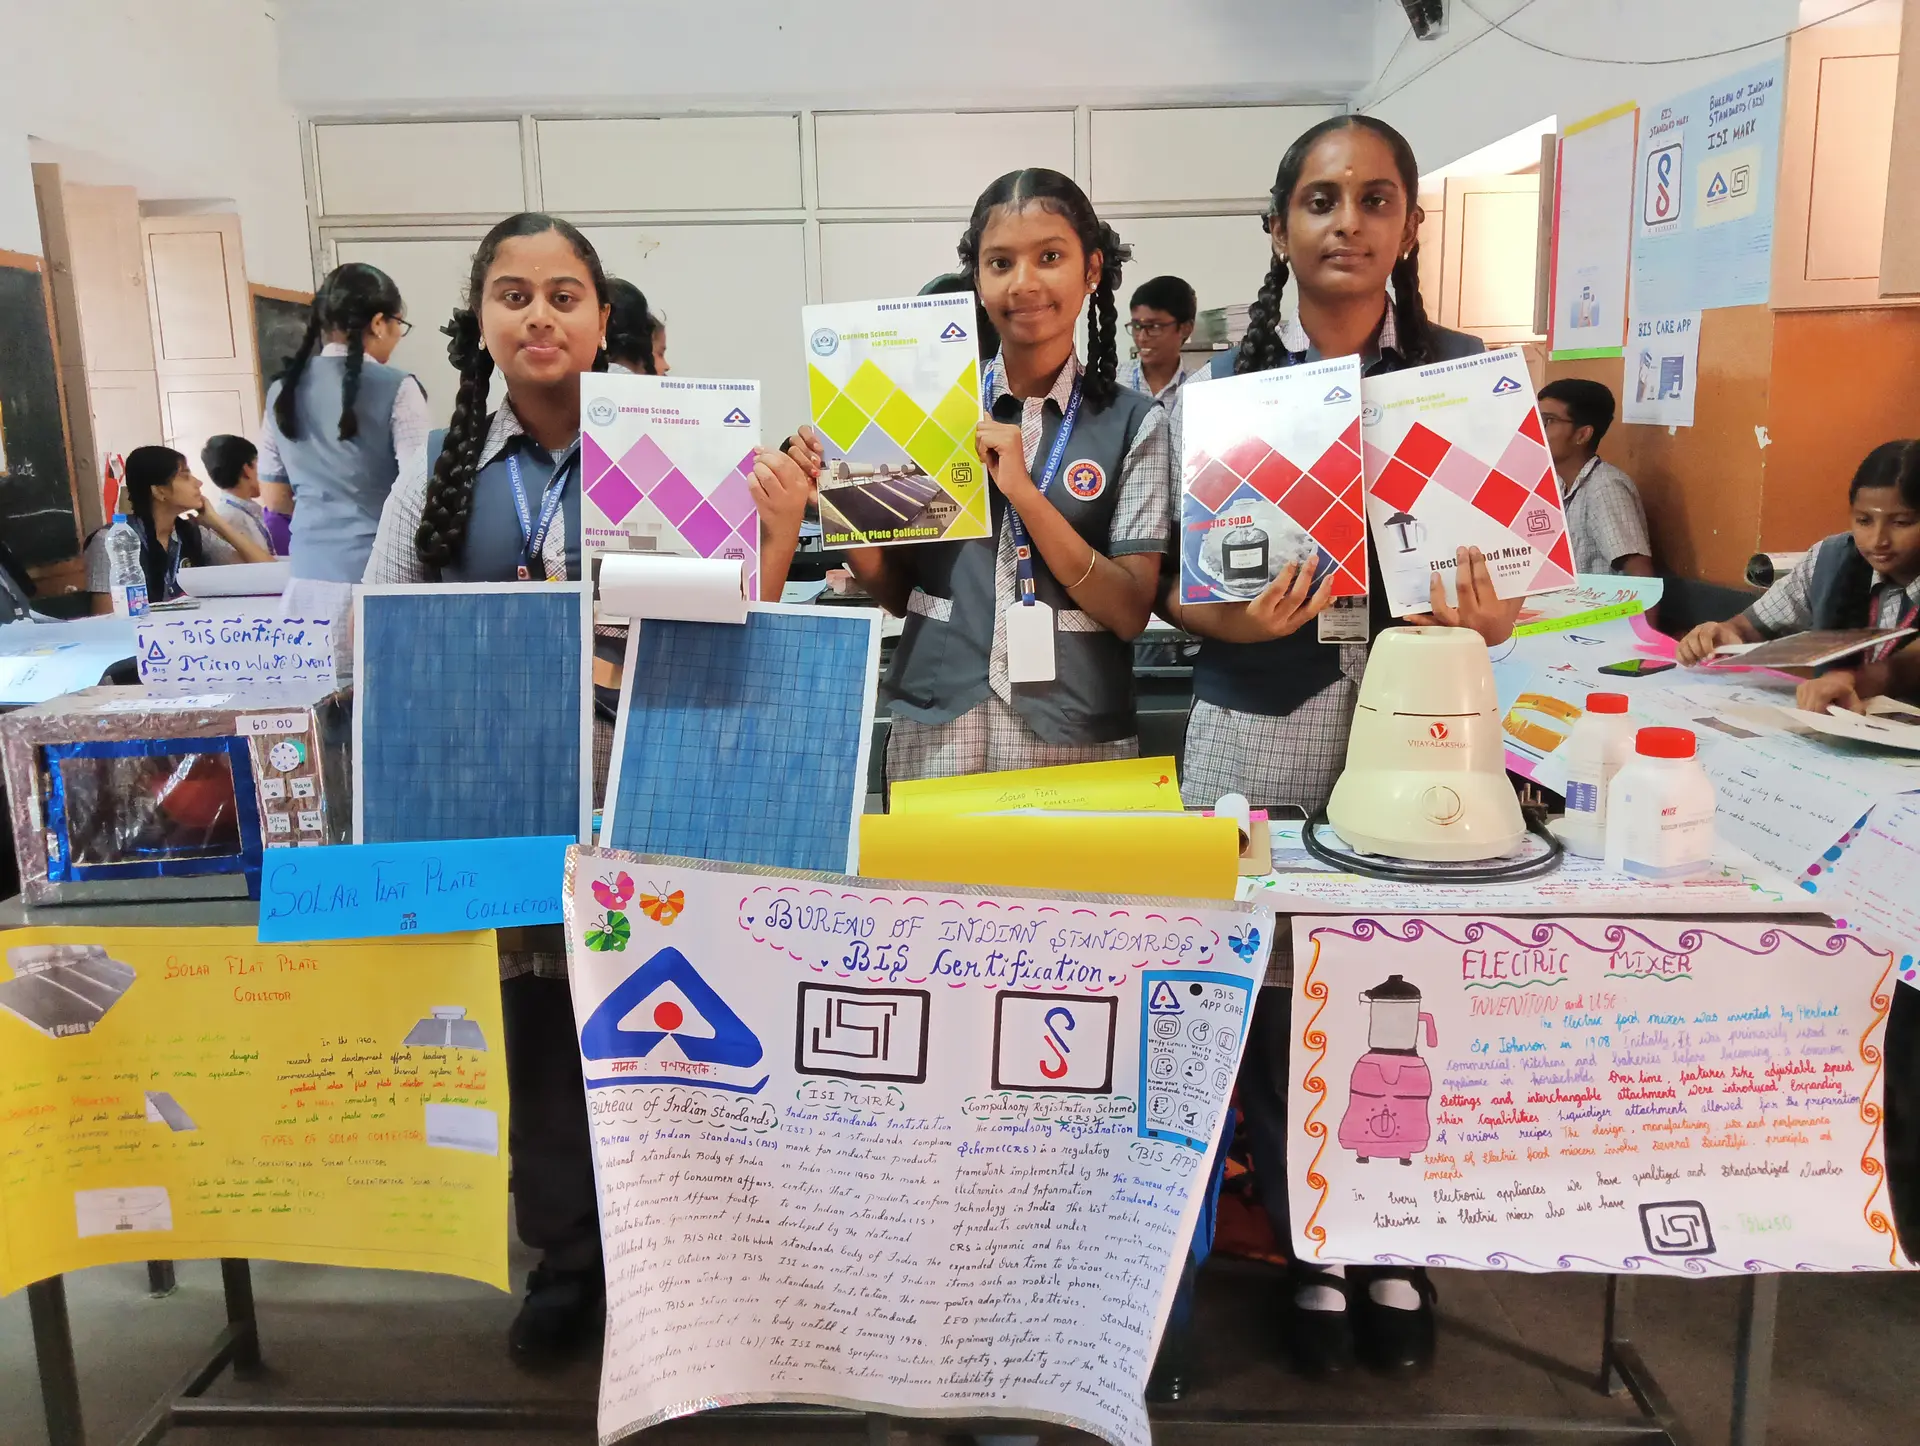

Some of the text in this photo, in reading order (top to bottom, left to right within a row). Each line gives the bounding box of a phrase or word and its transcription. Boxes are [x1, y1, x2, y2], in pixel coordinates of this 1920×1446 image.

[1708, 118, 1756, 150] ISI MARK
[877, 303, 901, 311] BUREAU
[933, 298, 968, 307] STANDARDS
[870, 330, 897, 338] Science
[1638, 319, 1692, 337] BIS CARE APP
[883, 338, 918, 346] Standards
[1420, 368, 1445, 377] BUREAU
[1456, 361, 1478, 370] INDIAN
[1480, 352, 1518, 365] STANDARDS
[618, 406, 680, 415] Learning Science
[664, 417, 700, 425] Standards
[1039, 471, 1052, 495] ANCIS
[1049, 410, 1074, 470] MATRICULATION
[517, 494, 530, 523] FRANCIS
[540, 495, 558, 526] FRANCIS
[926, 506, 948, 514] Lesson
[1229, 516, 1252, 526] SODA
[585, 527, 630, 537] Microwave
[825, 527, 939, 542] Solar Flat Plate Collectors
[585, 538, 605, 547] Oven
[1430, 558, 1458, 571] Elect
[1502, 546, 1532, 558] Mixer
[1497, 564, 1520, 572] Lesson
[181, 629, 216, 645] BIS
[1408, 740, 1469, 748] VIJAYALAKSHM
[1662, 807, 1677, 816] NICE
[266, 863, 361, 922] SOLAR
[423, 857, 479, 895] PLATE
[465, 898, 560, 921] COLLECTOR
[765, 898, 1194, 957] BUREAU OF INDIAN STANDARDS
[164, 955, 210, 980] SOLAR
[276, 953, 320, 972] PLATE
[842, 940, 1102, 986] BIS Certification
[1462, 948, 1693, 980] ELECTRIC MIXER
[233, 986, 291, 1002] COLLECTOR
[1214, 989, 1234, 1000] BIS
[1564, 994, 1584, 1009] and
[1200, 999, 1243, 1016] APP CARE
[57, 1023, 85, 1036] Plate
[1560, 1035, 1611, 1049] in 1908
[320, 1054, 383, 1063] and development
[809, 1089, 896, 1106] ISI MARK
[1490, 1092, 1514, 1105] and
[1527, 1087, 1602, 1108] interchangable
[1688, 1082, 1714, 1096] were
[1701, 1099, 1744, 1114] allowed
[1759, 1097, 1779, 1112] for
[1786, 1096, 1799, 1107] the
[1804, 1091, 1861, 1106] preparation
[591, 1095, 771, 1126] Bureau of Indian Standards
[785, 1106, 818, 1121] Indian
[968, 1096, 1132, 1120] Compulsory Registration Scheme
[600, 1134, 630, 1146] Bureau
[639, 1133, 650, 1145] of
[655, 1128, 691, 1140] Indian
[700, 1132, 753, 1146] Standards
[1059, 1120, 1133, 1139] Registration
[1136, 1147, 1198, 1172] BIS APP
[955, 1162, 1005, 1180] framework
[1009, 1161, 1075, 1180] implemented
[1080, 1166, 1091, 1181] by
[1008, 1184, 1030, 1195] and
[1032, 1181, 1092, 1199] Information
